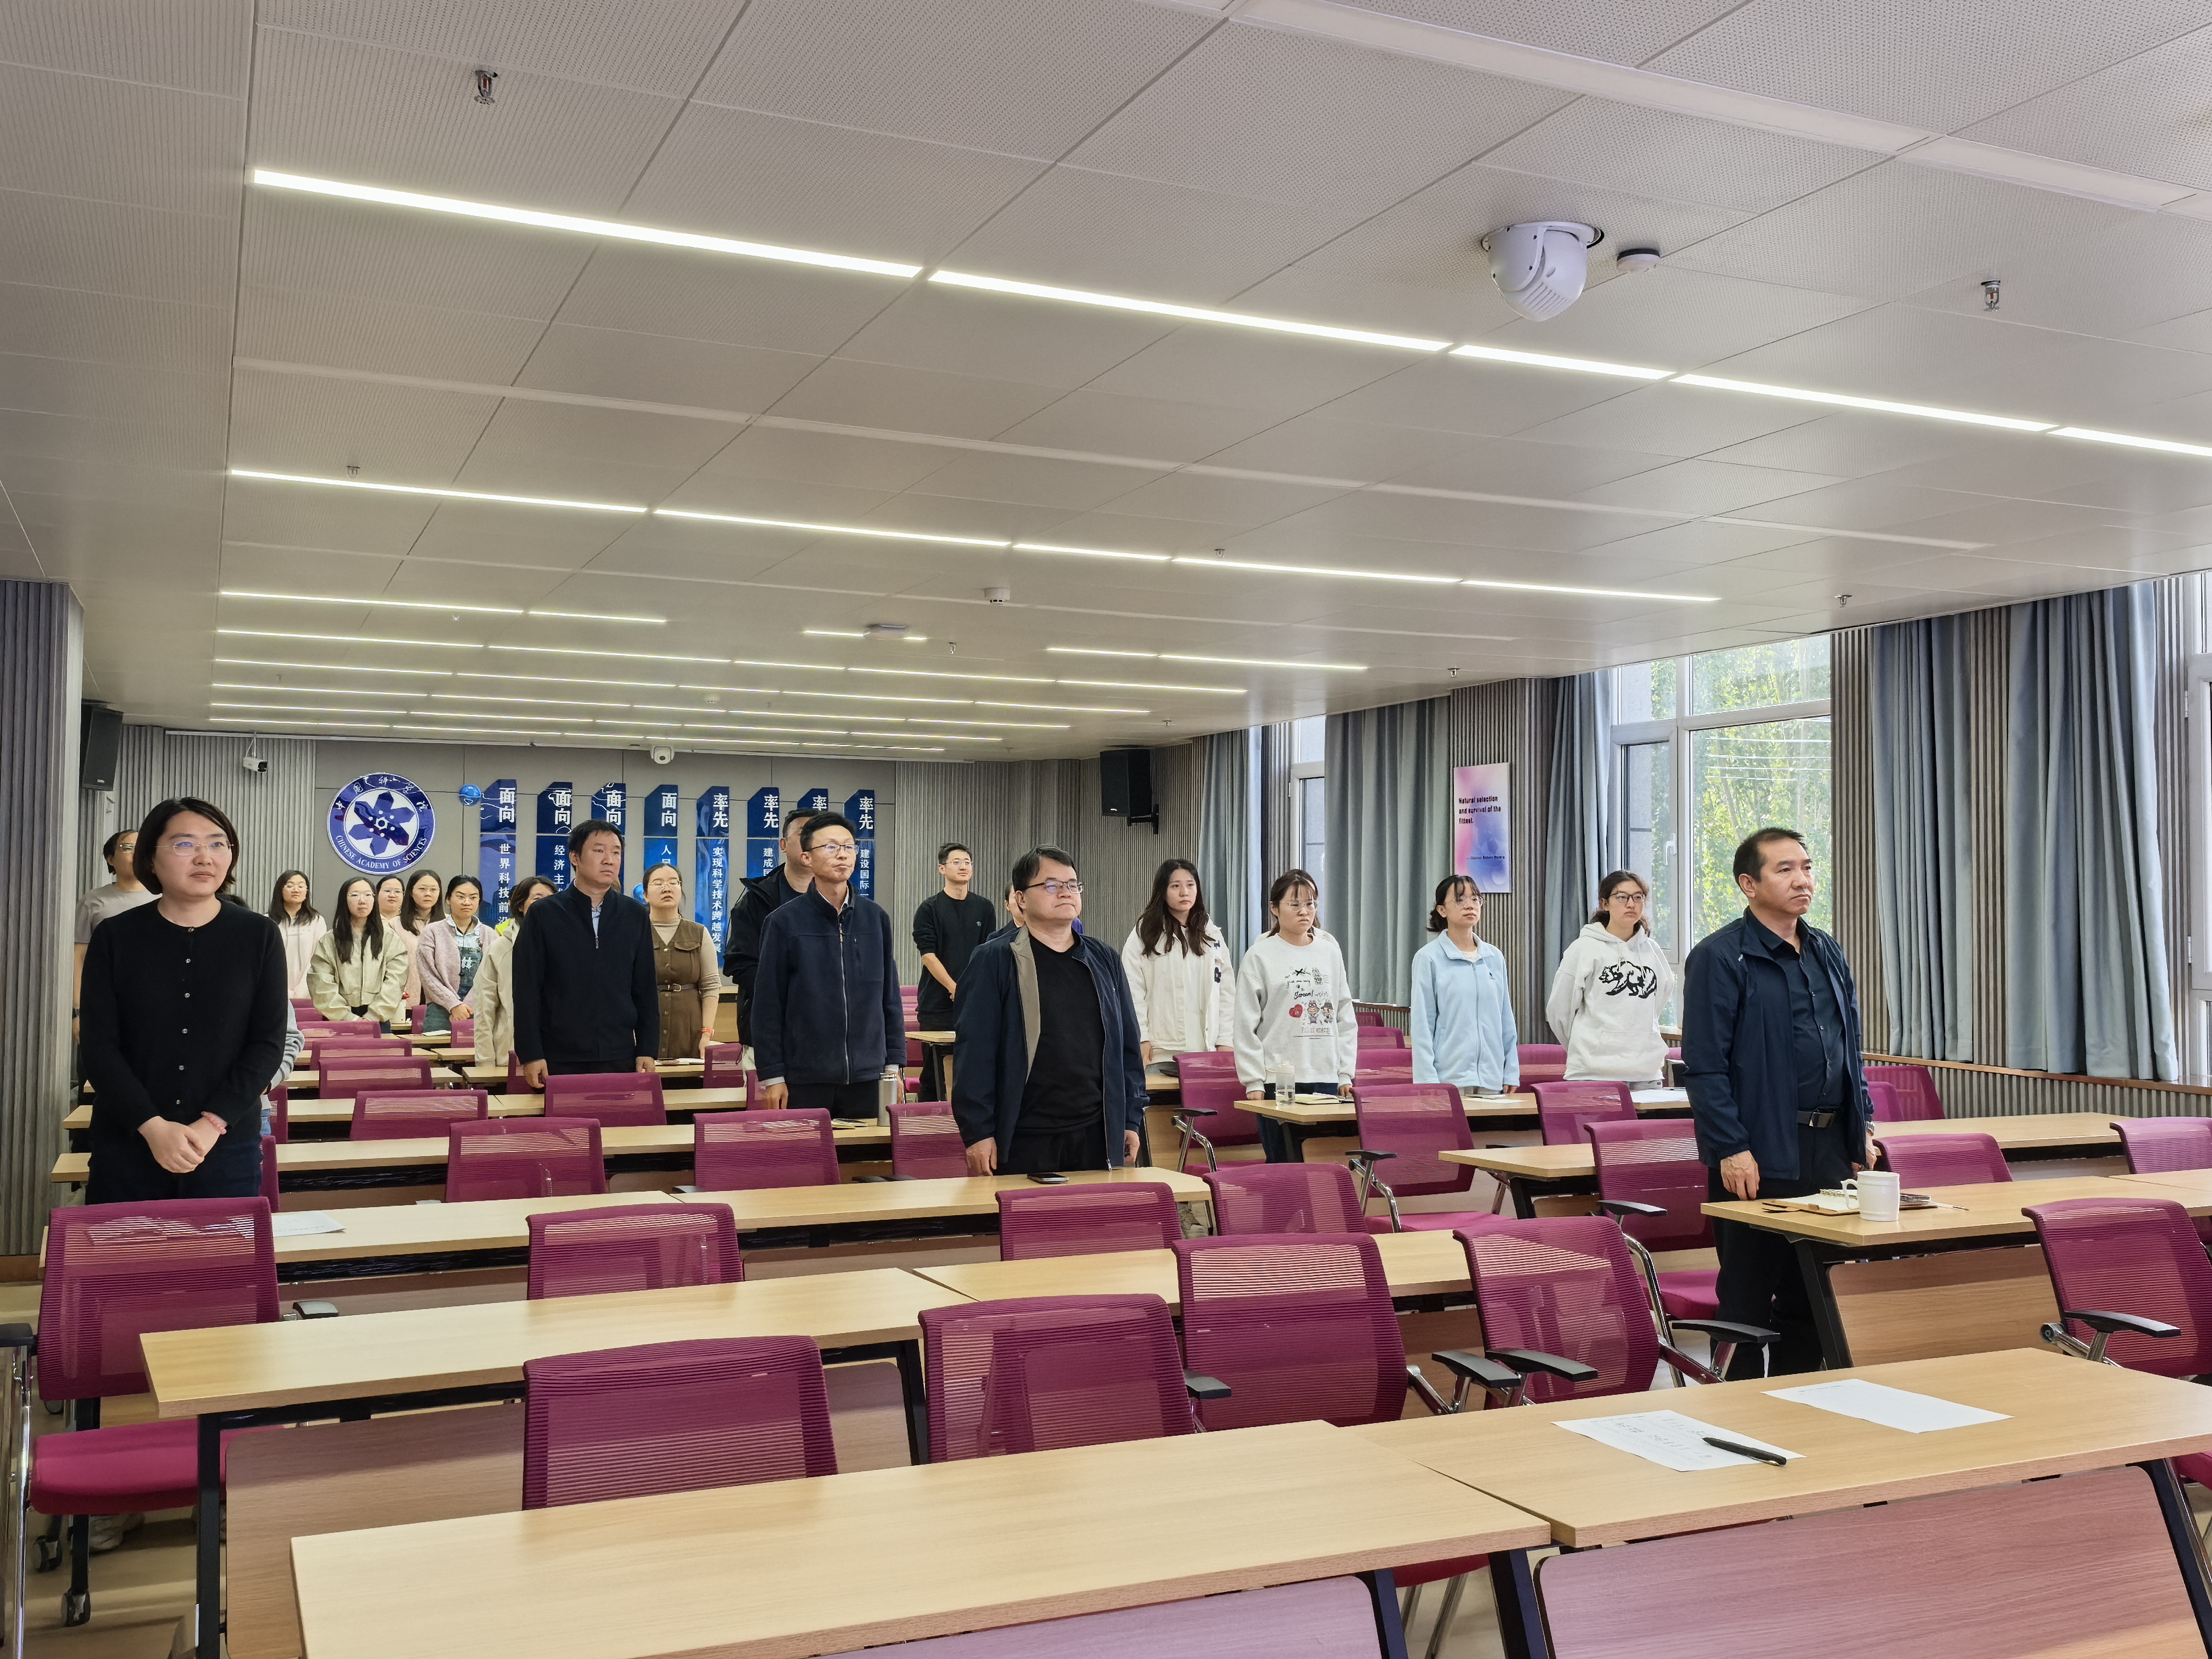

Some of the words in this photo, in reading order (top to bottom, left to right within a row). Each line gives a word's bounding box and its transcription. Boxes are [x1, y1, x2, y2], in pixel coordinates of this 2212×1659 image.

[499, 787, 515, 822] 面向
[555, 791, 571, 825] 面向
[606, 791, 622, 825] 面向
[662, 792, 678, 826] 面向
[713, 793, 729, 828] 率先
[764, 794, 779, 828] 率先
[859, 797, 874, 830] 率先
[336, 835, 357, 860] CHINESE
[356, 857, 390, 869] ACADEMY
[393, 859, 401, 867] OF
[402, 837, 427, 863] SCIENCES
[711, 847, 724, 953] 实现科学技术跨越发展
